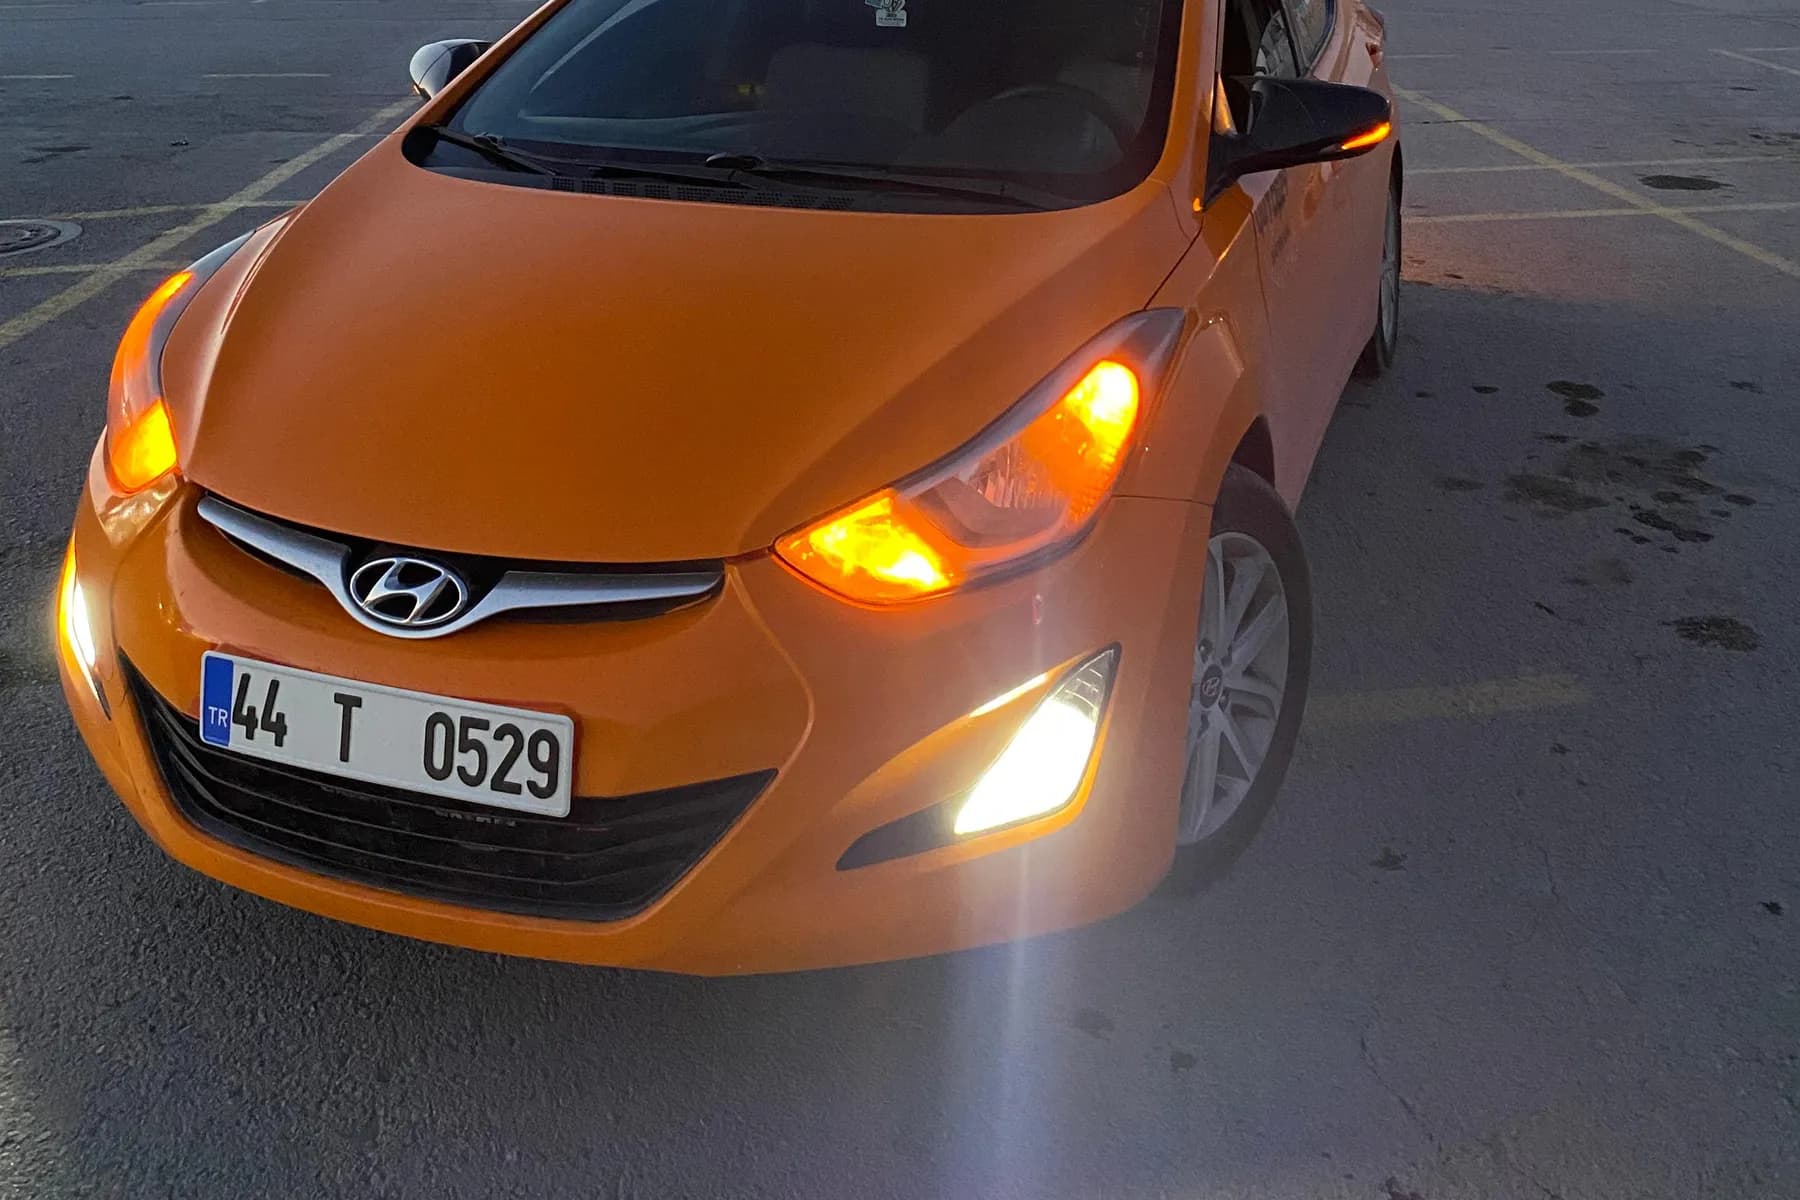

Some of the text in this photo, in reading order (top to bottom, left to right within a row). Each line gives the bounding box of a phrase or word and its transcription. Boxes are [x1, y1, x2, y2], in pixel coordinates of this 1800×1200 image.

[208, 706, 229, 728] TR
[232, 673, 560, 799] 44 T 0529
